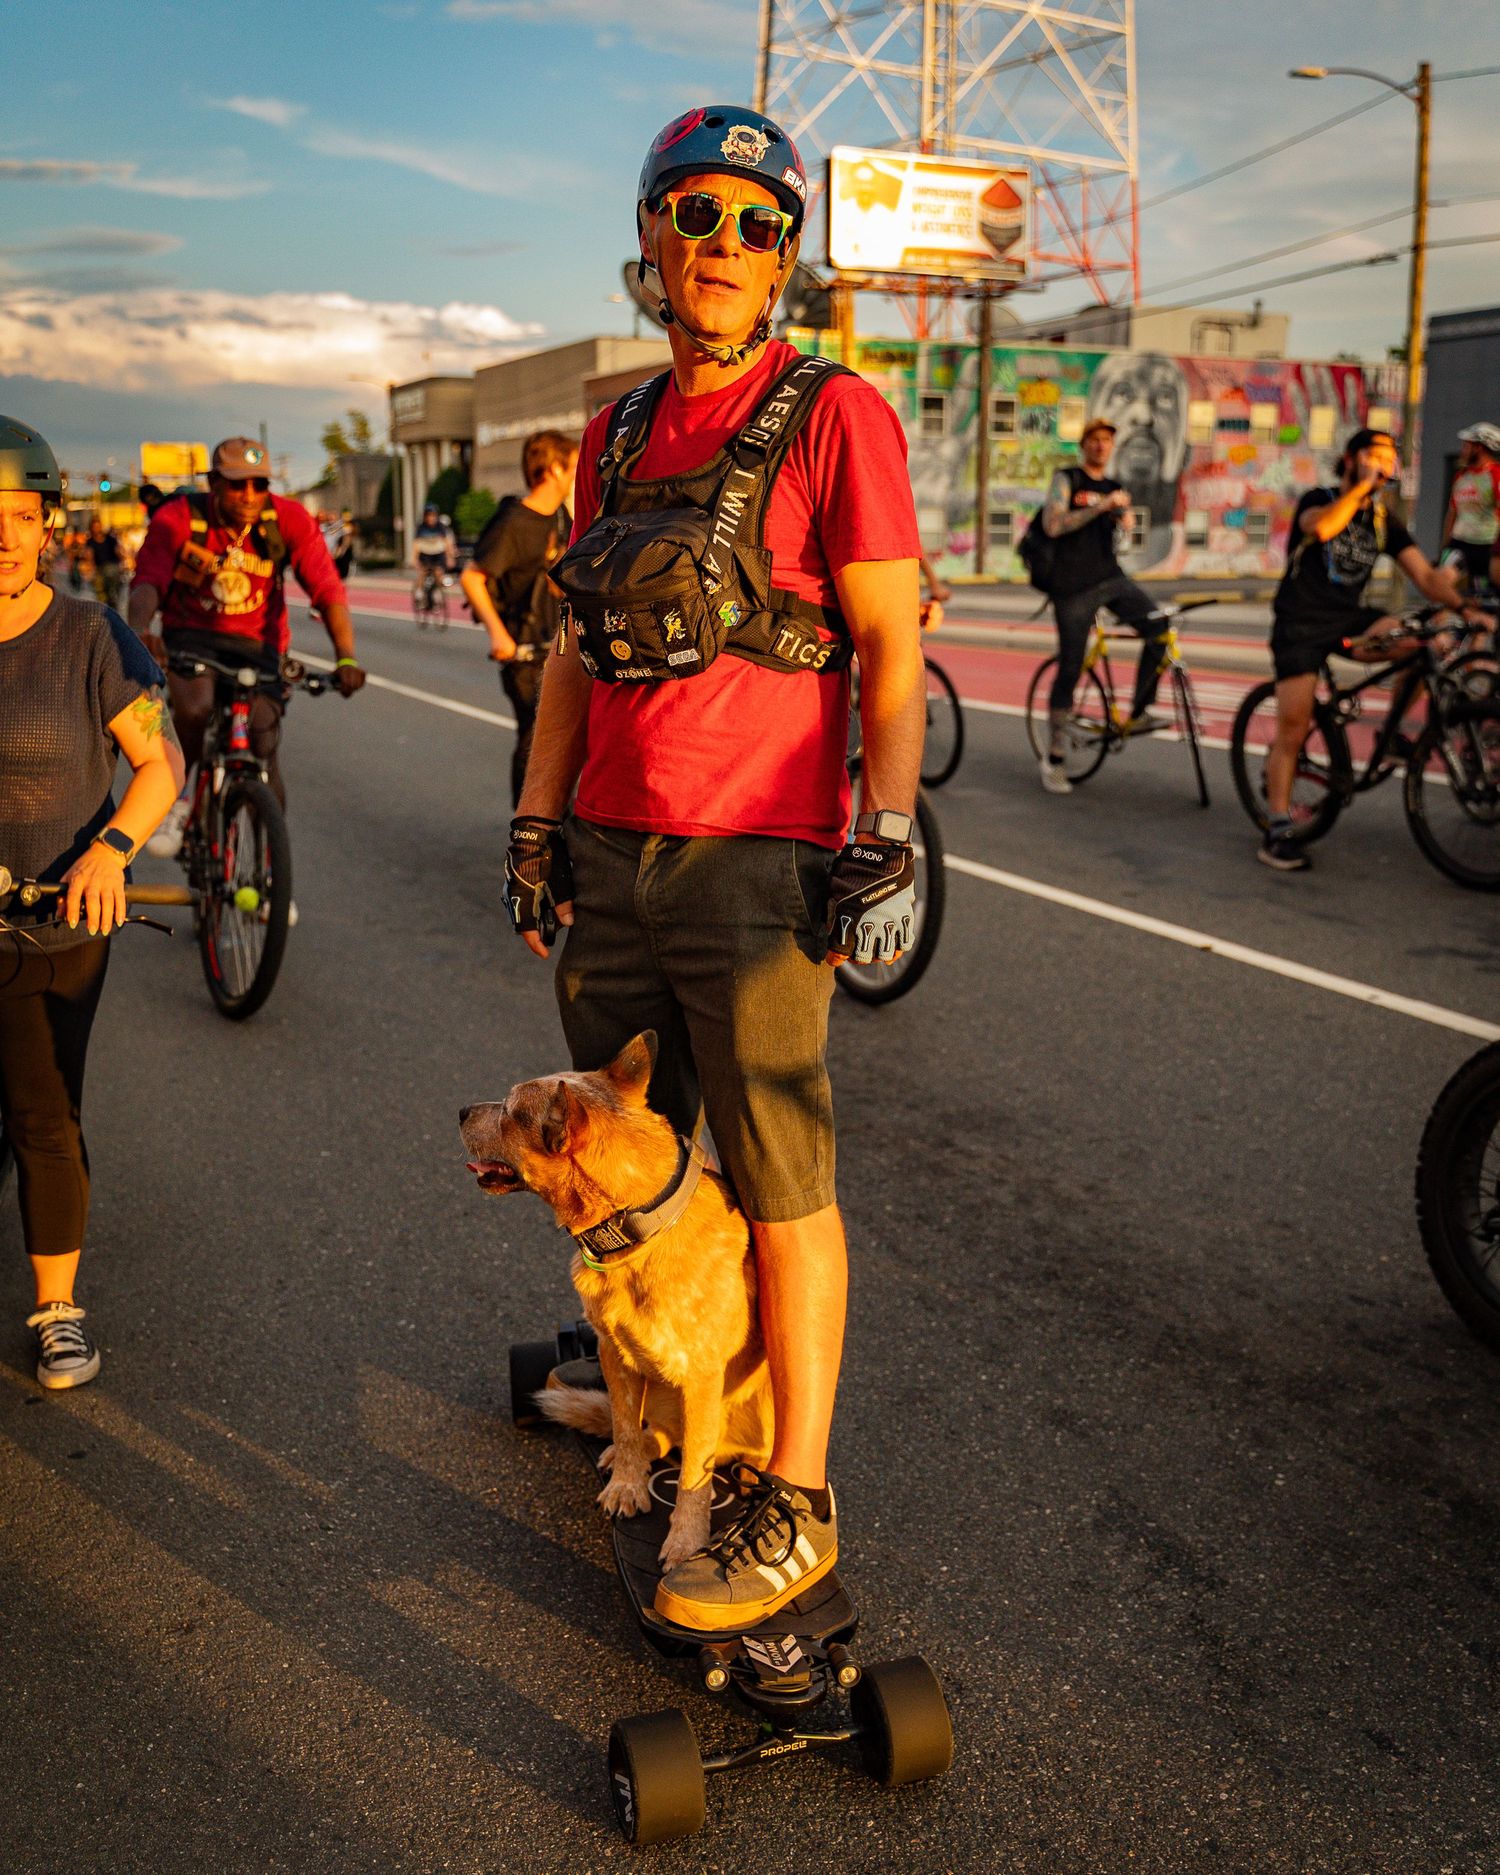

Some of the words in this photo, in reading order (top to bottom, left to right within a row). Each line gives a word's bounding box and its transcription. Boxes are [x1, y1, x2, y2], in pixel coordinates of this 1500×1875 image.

[734, 468, 756, 479] I
[712, 490, 749, 549] WILL
[777, 629, 831, 669] TICS
